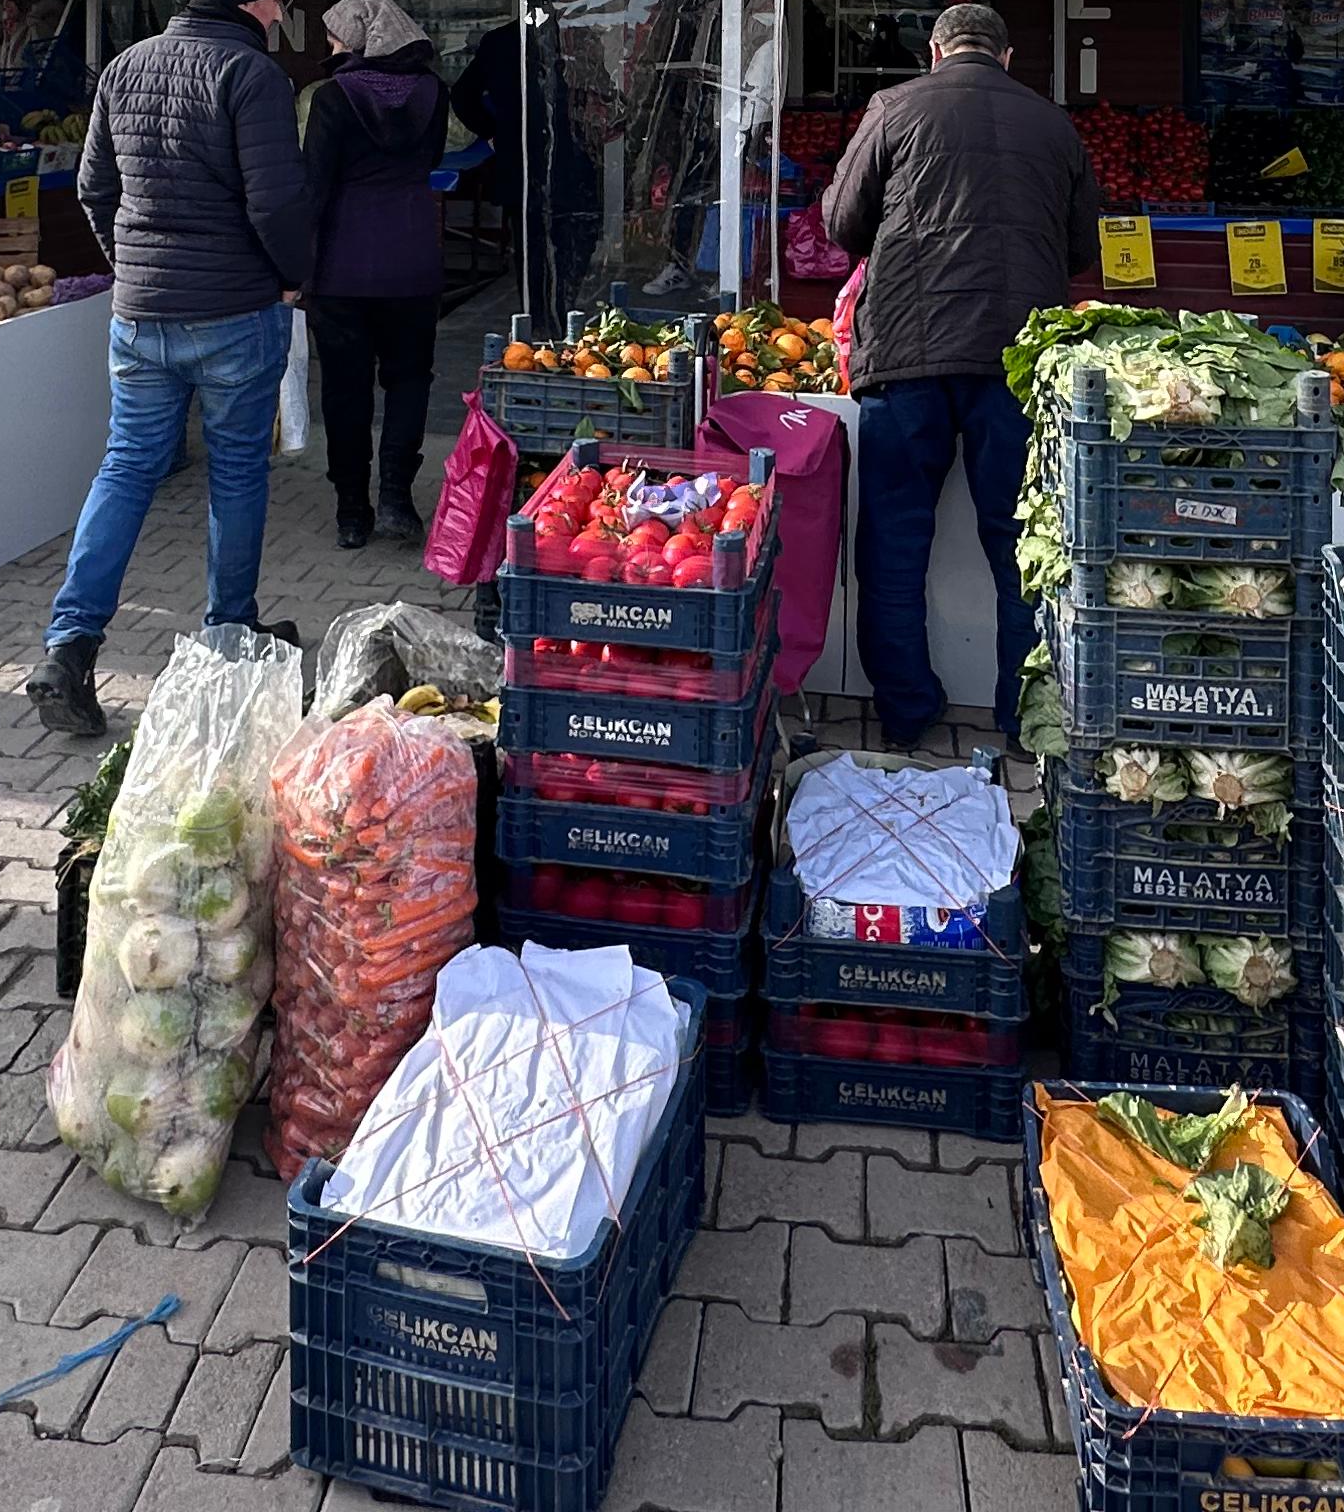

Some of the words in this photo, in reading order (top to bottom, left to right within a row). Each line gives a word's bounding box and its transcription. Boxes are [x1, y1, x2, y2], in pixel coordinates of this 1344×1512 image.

[1130, 696, 1208, 714] SEBZE
[1145, 683, 1256, 705] MALATYA
[1133, 866, 1273, 891] MALATYA
[1132, 882, 1188, 898] SEBZE
[1234, 890, 1274, 903] 2024
[1130, 1051, 1274, 1078] MALATYA
[410, 1335, 497, 1363] MALATYA
